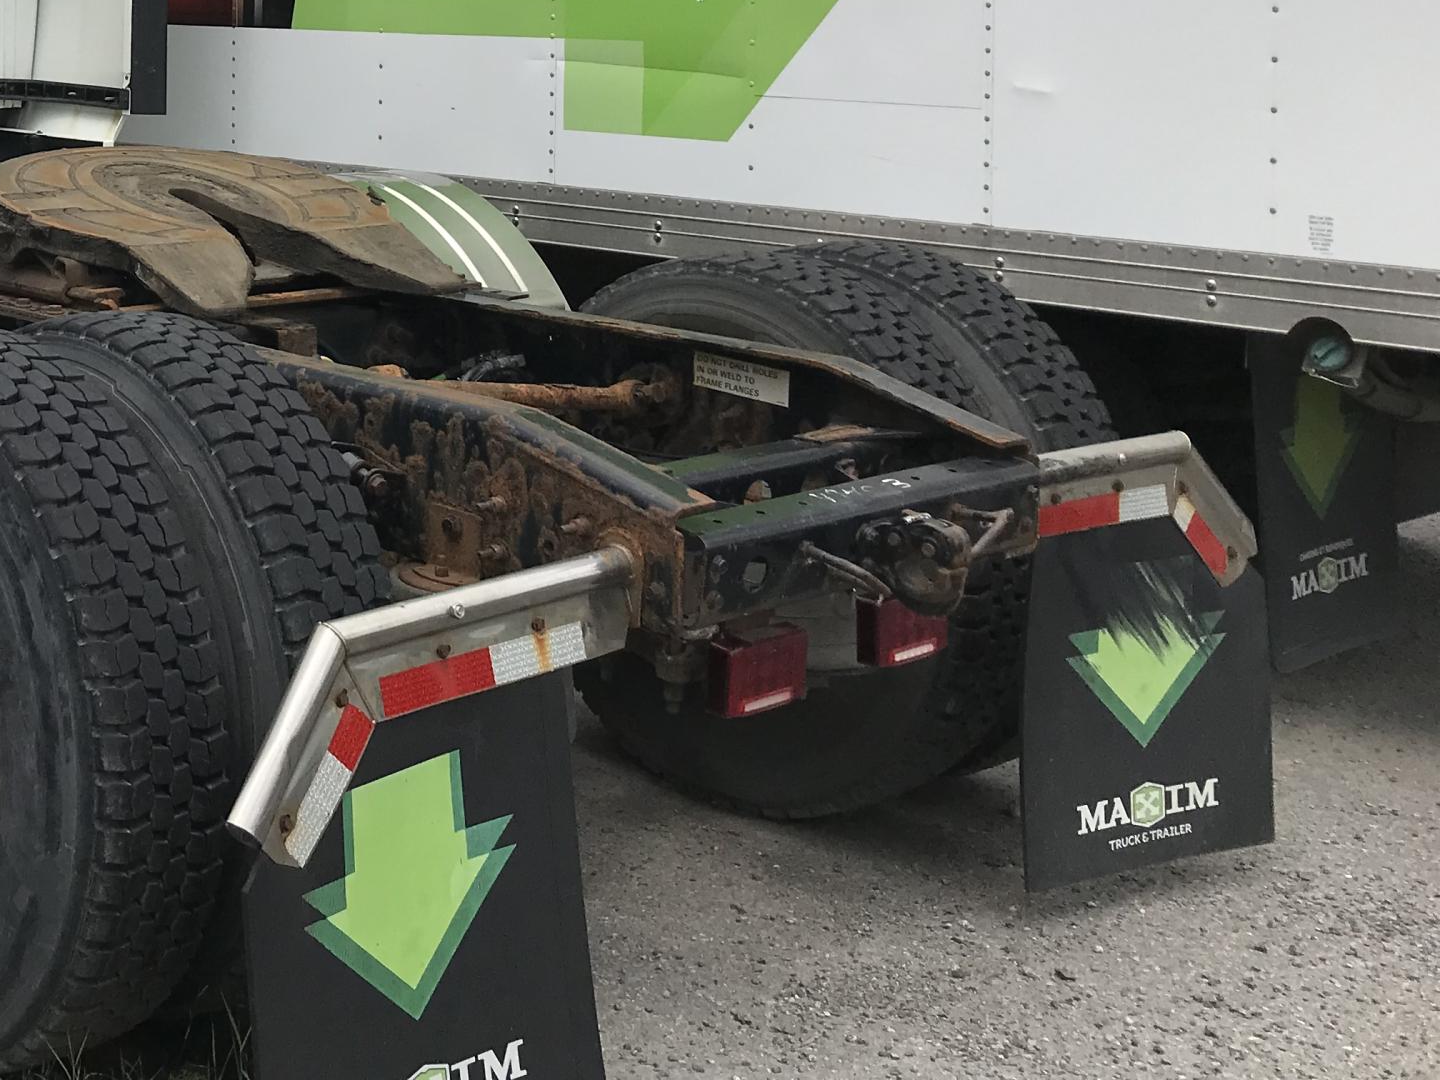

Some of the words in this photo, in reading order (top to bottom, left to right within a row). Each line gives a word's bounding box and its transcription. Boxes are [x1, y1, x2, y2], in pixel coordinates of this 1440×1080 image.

[696, 365, 705, 374] IN
[707, 368, 718, 377] OR
[720, 370, 742, 382] WELD
[744, 375, 755, 385] TO
[696, 376, 722, 388] FRAME
[724, 382, 759, 397] FLANGES
[1291, 553, 1369, 600] MAXIM
[1076, 778, 1219, 835] MAXIM
[1108, 834, 1141, 851] TRUCK
[1142, 831, 1149, 843] &
[1149, 823, 1193, 841] TRAILER
